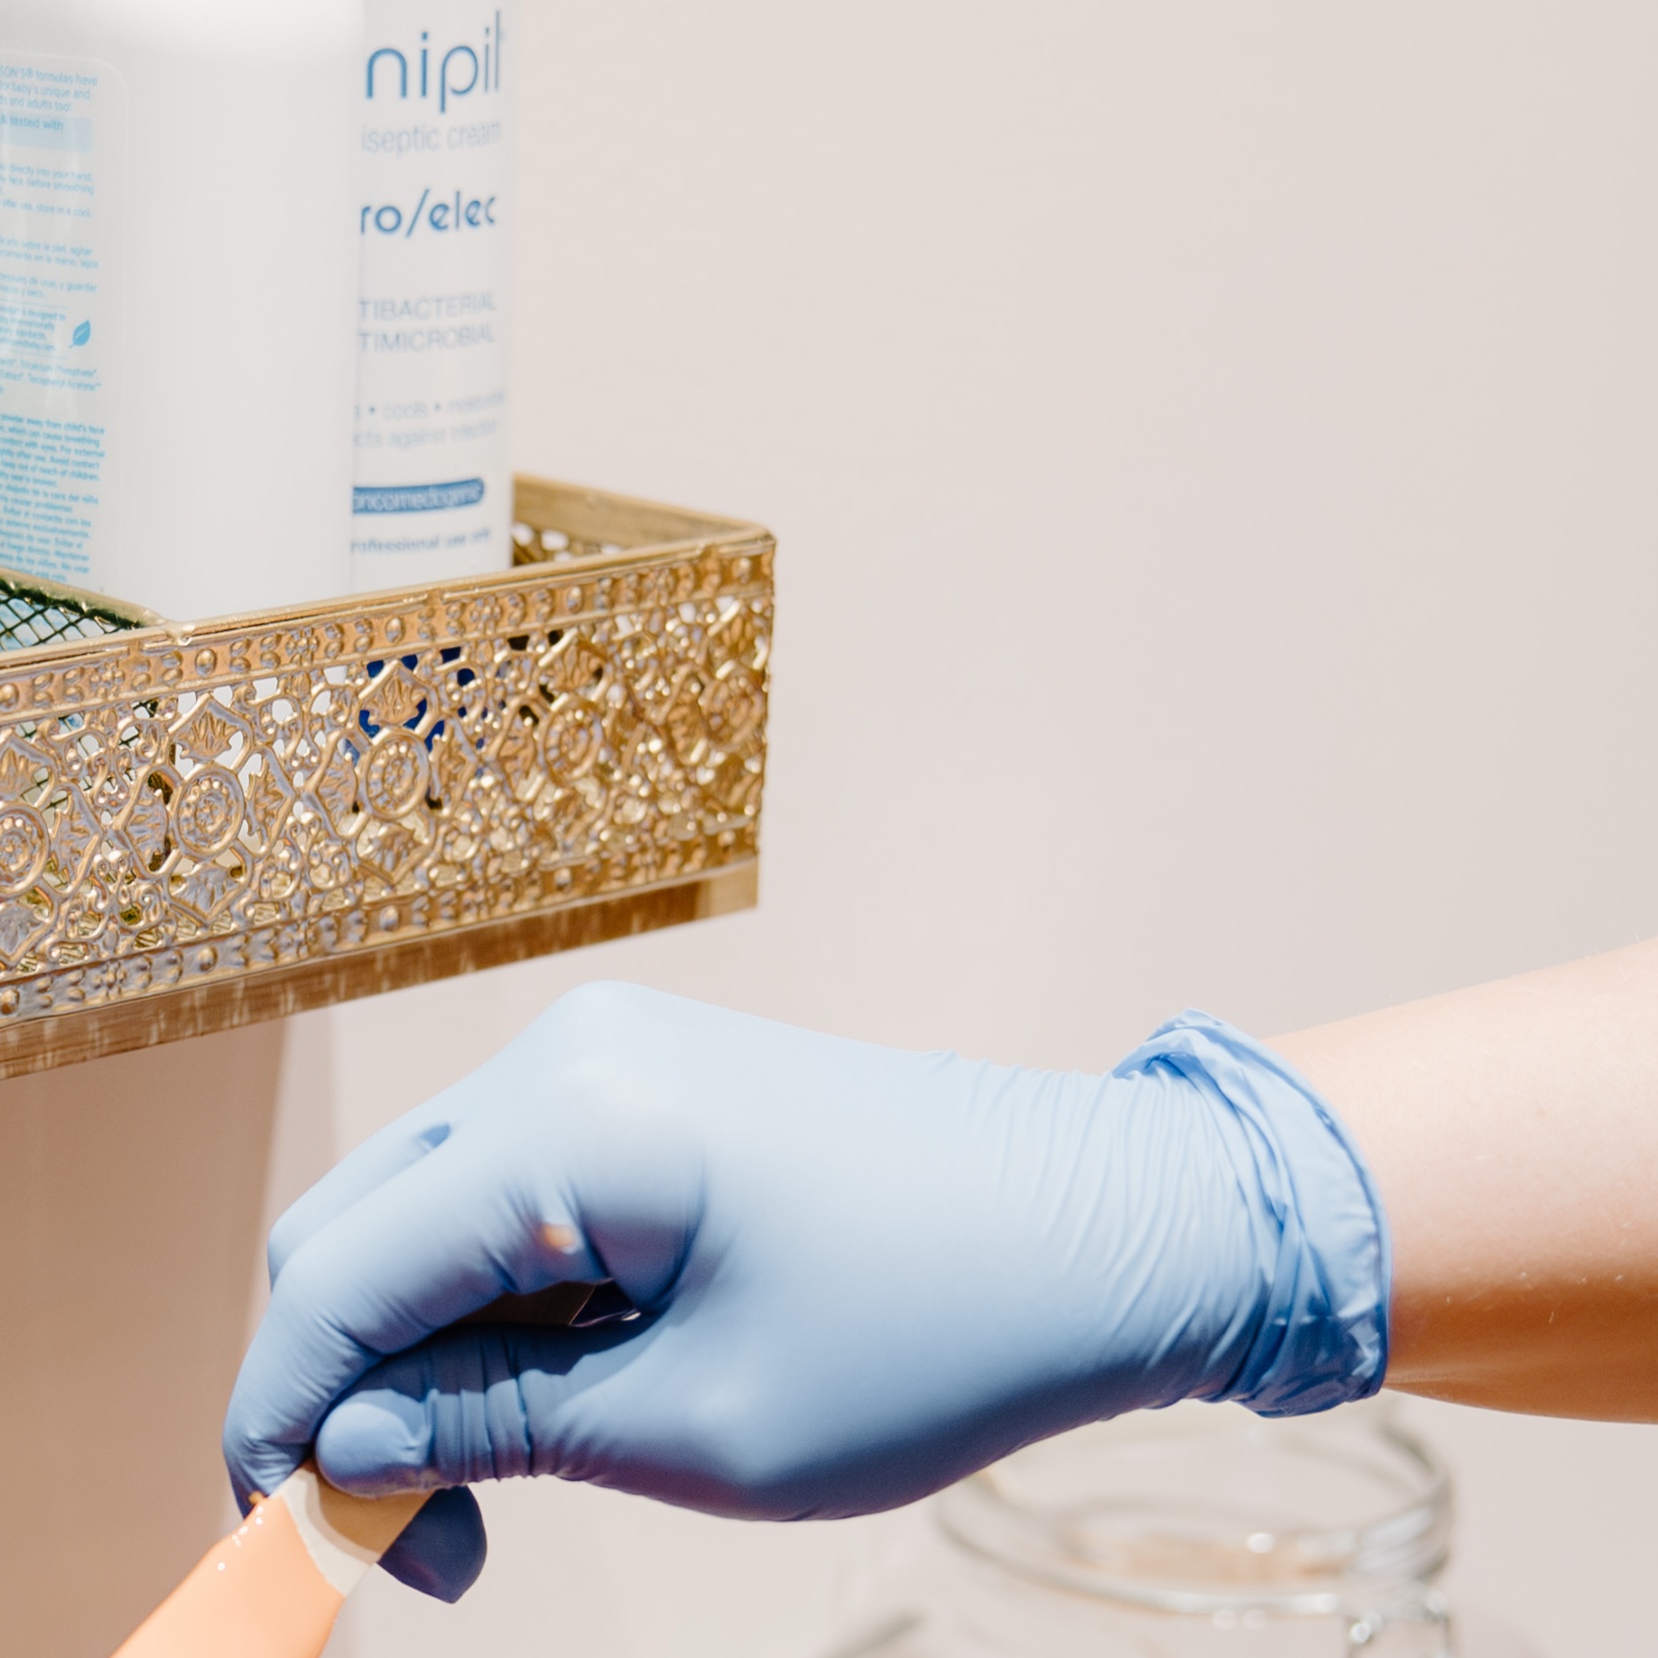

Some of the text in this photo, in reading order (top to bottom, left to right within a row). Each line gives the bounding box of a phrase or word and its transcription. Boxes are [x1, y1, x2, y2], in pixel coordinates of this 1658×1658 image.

[35, 68, 73, 83] formulas
[75, 73, 98, 86] have
[40, 87, 70, 100] unique
[73, 88, 91, 100] and
[9, 114, 40, 128] tested
[42, 117, 64, 131] with
